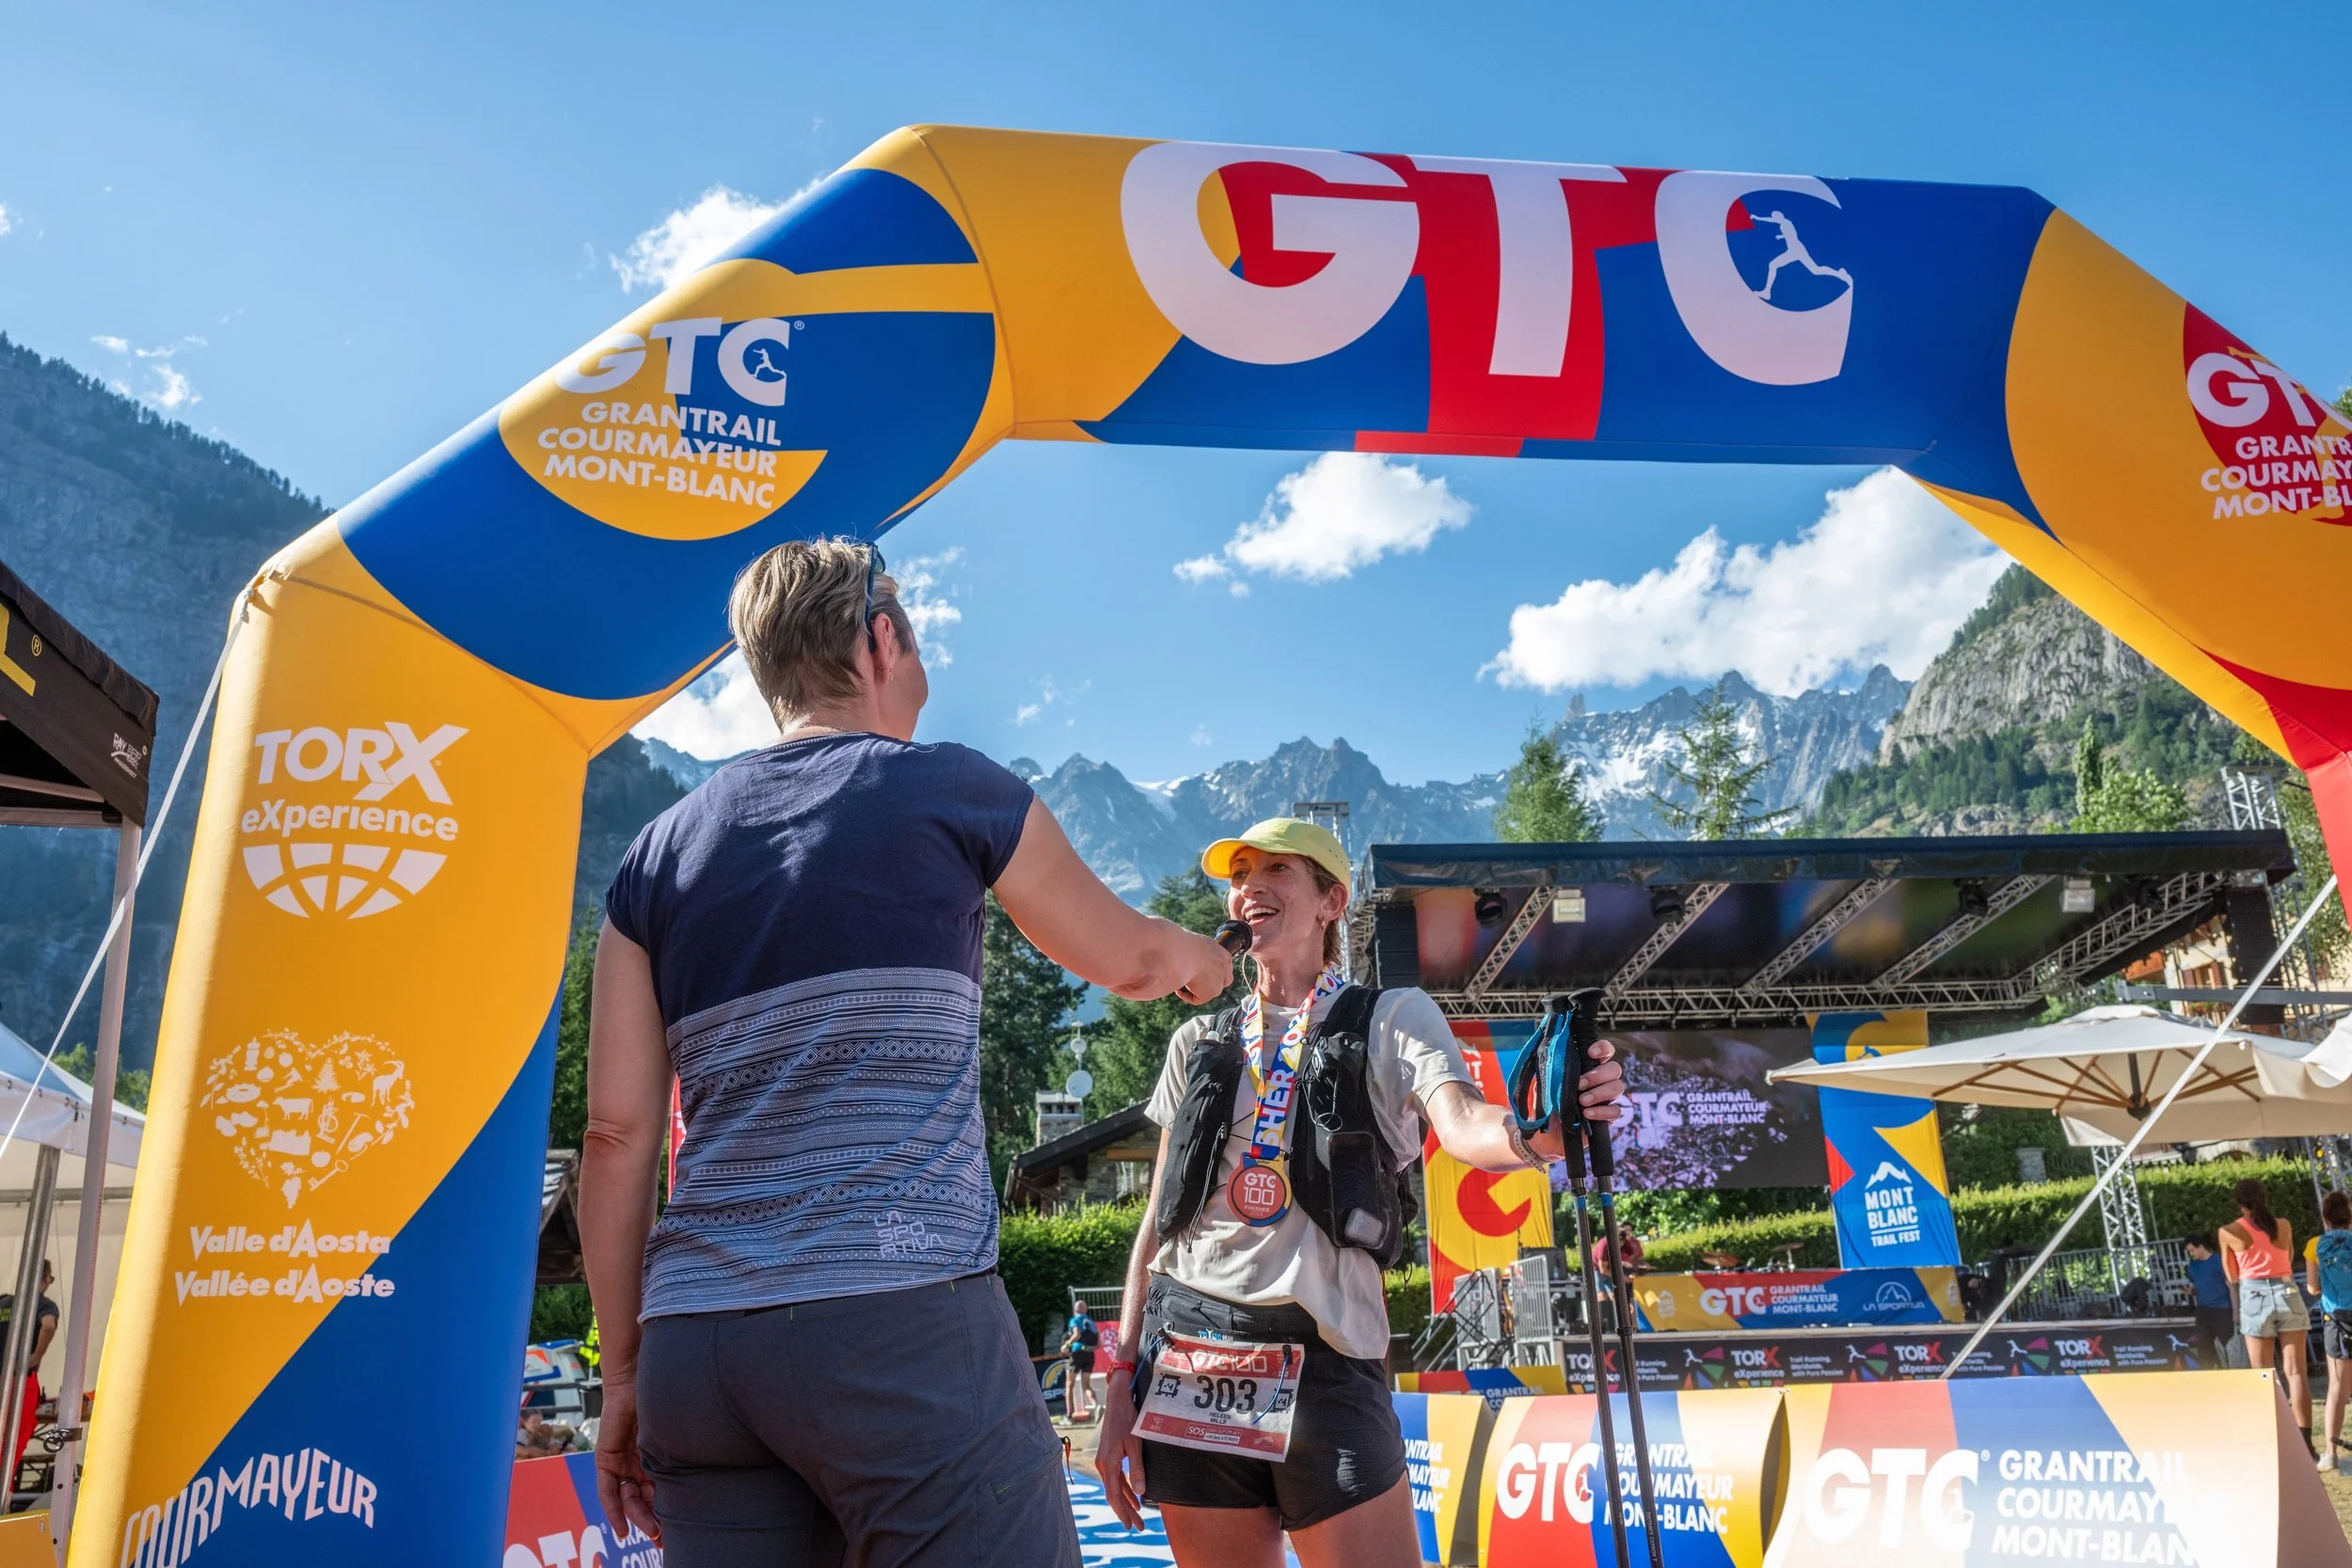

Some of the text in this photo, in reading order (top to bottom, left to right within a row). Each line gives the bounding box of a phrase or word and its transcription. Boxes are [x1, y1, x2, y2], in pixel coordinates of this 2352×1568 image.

[1120, 140, 1853, 385] GTC
[555, 317, 790, 406] GTC
[581, 402, 781, 447] GRANTRAIL
[538, 428, 777, 477] COURMAYEUR
[2235, 436, 2352, 460] GRANTR
[544, 455, 775, 509] MONT-BLANC
[2201, 460, 2352, 492] COURMAY
[2213, 485, 2352, 519] MONT-BL
[255, 721, 469, 805] TORX
[241, 799, 459, 841] eXperience
[1687, 1092, 1752, 1102] GRANTRAIL
[1687, 1101, 1767, 1114] COURMAYEUR
[1690, 1113, 1765, 1125] MONT-BLANC
[1245, 1172, 1277, 1188] GTC
[1244, 1186, 1275, 1205] 100
[1865, 1186, 1914, 1211] MONT
[1867, 1205, 1918, 1229] BLANC
[190, 1218, 391, 1261] Valle d'Aosta
[1870, 1229, 1920, 1247] TRAIL FEST
[175, 1263, 395, 1307] Vallée d'Aoste
[1770, 1284, 1826, 1294] GRANTRAIL
[1700, 1286, 1767, 1315] GTC
[1770, 1293, 1839, 1305] COURMAYEUR
[1772, 1303, 1838, 1313] MONT-BLANC
[1730, 1346, 1781, 1369] TORX
[1894, 1340, 1945, 1365] TORX
[2055, 1335, 2106, 1359] TORX
[1734, 1369, 1786, 1379] eXperience
[2060, 1358, 2110, 1368] eXperience
[1194, 1375, 1257, 1415] 303
[1187, 1426, 1205, 1436] SOS
[1496, 1442, 1600, 1525] GTC
[1804, 1448, 1979, 1552] GTC
[1991, 1526, 2196, 1566] MONT-BLAN
